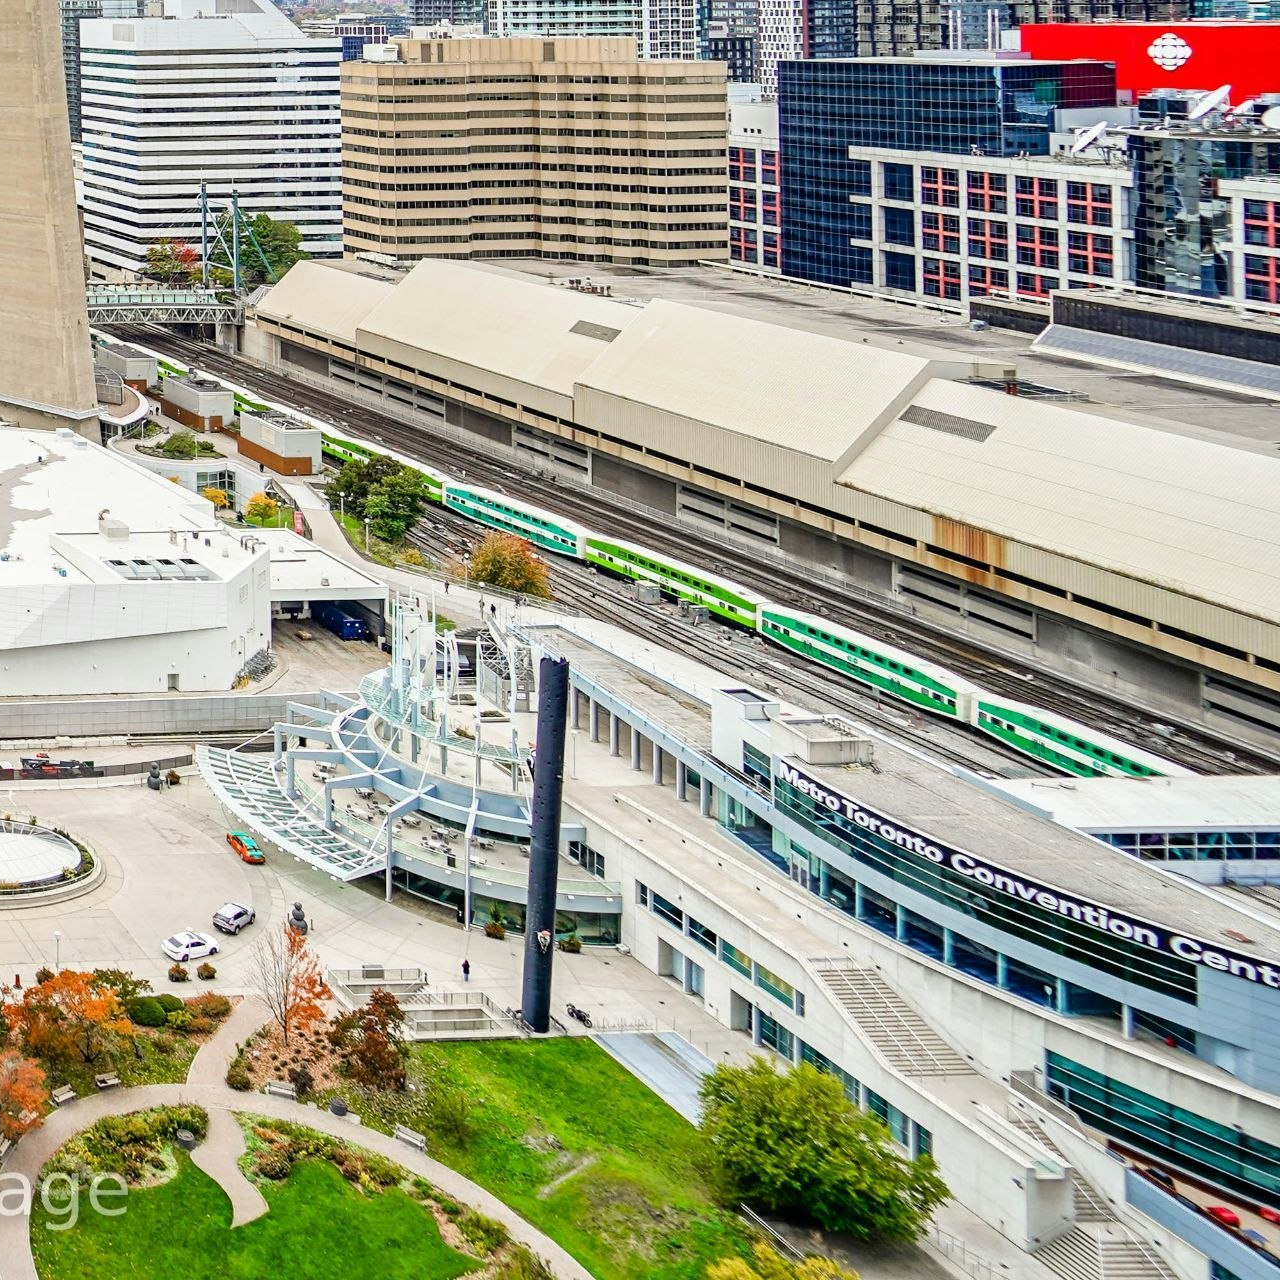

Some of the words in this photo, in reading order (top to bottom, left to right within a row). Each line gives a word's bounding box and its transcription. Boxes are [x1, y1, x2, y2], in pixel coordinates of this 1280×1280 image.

[779, 762, 840, 811] Metro
[841, 798, 943, 863] Toronto
[951, 852, 1159, 949] Convention
